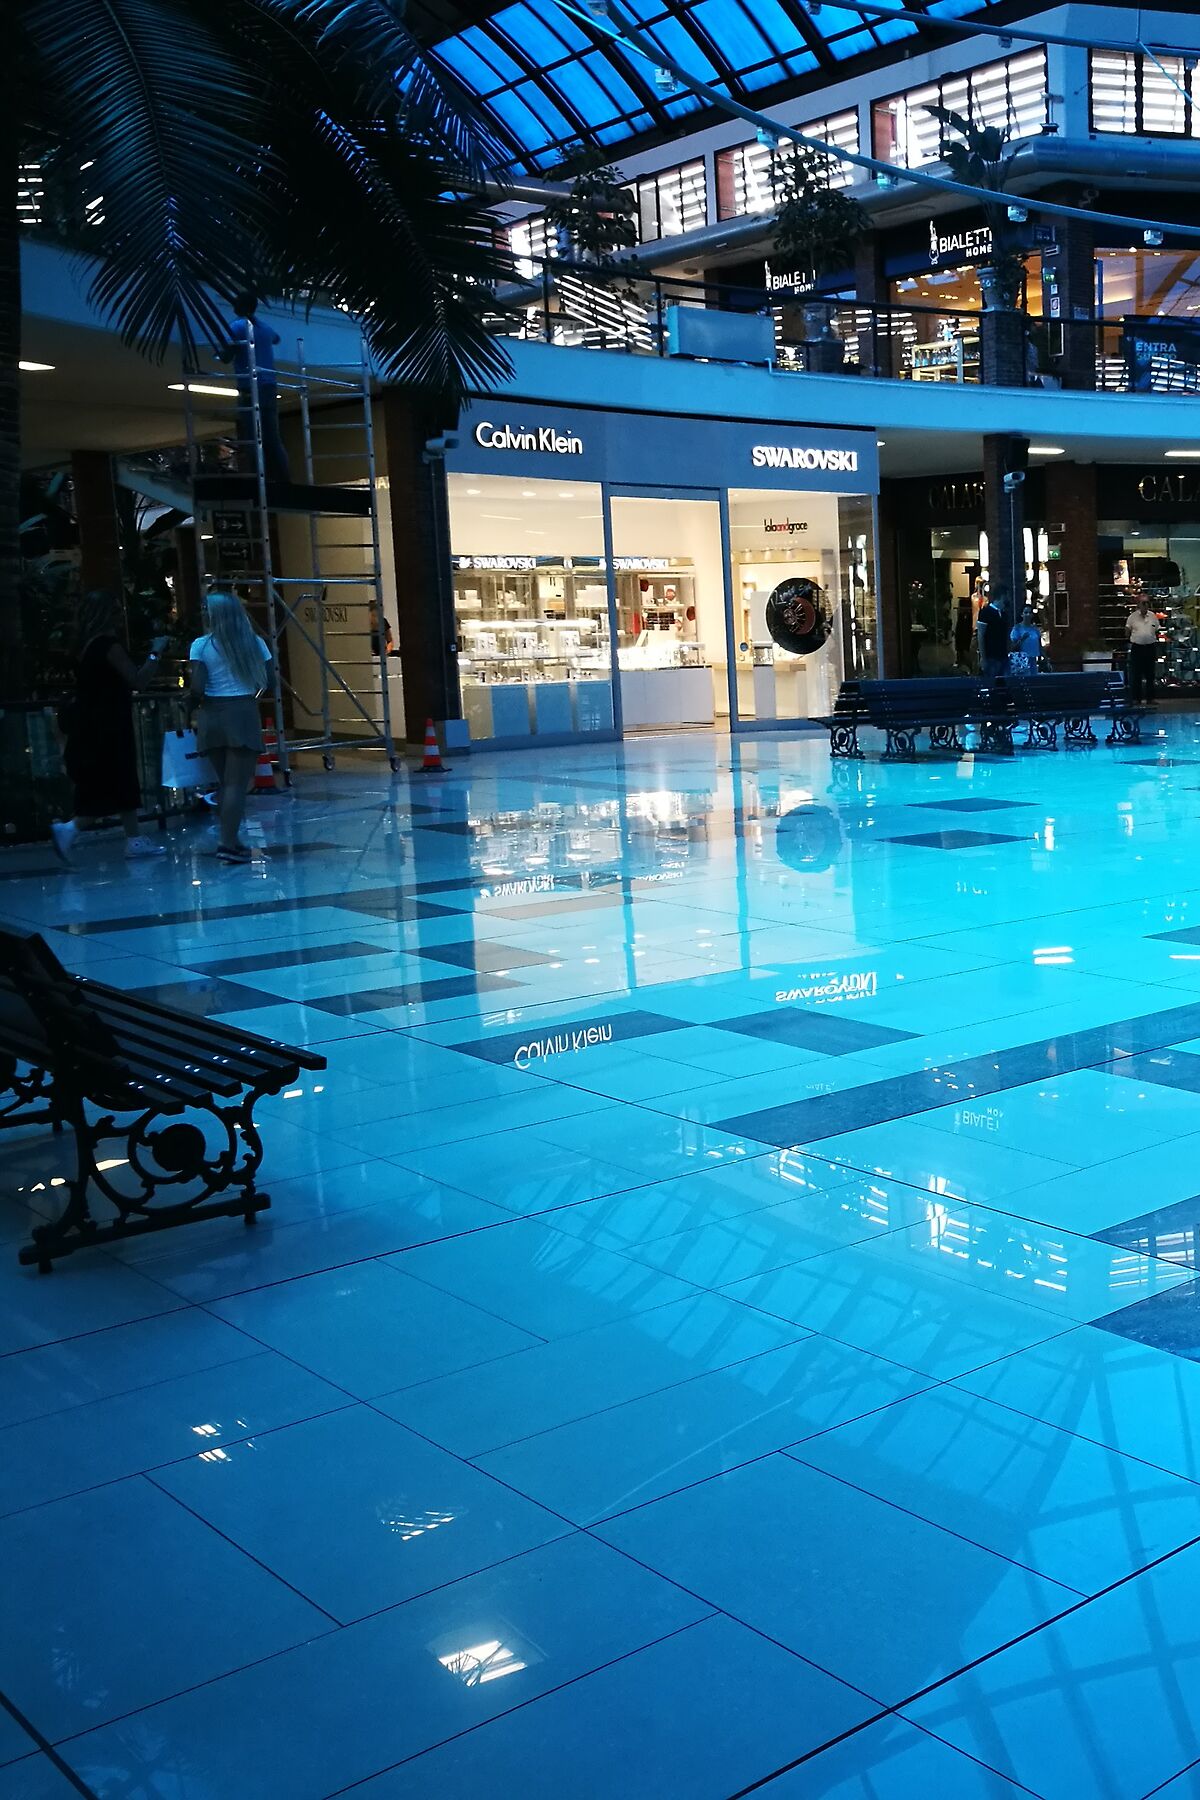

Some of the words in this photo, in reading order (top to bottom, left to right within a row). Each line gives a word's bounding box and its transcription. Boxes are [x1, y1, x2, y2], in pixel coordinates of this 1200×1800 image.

[966, 244, 993, 257] HOME
[1135, 342, 1177, 352] ENTRA
[475, 421, 537, 450] Calvin
[539, 428, 583, 455] Klein
[751, 445, 859, 471] SWAROVSKI
[473, 557, 537, 570] SWAROVSKI
[612, 558, 669, 571] SWAROVSKI
